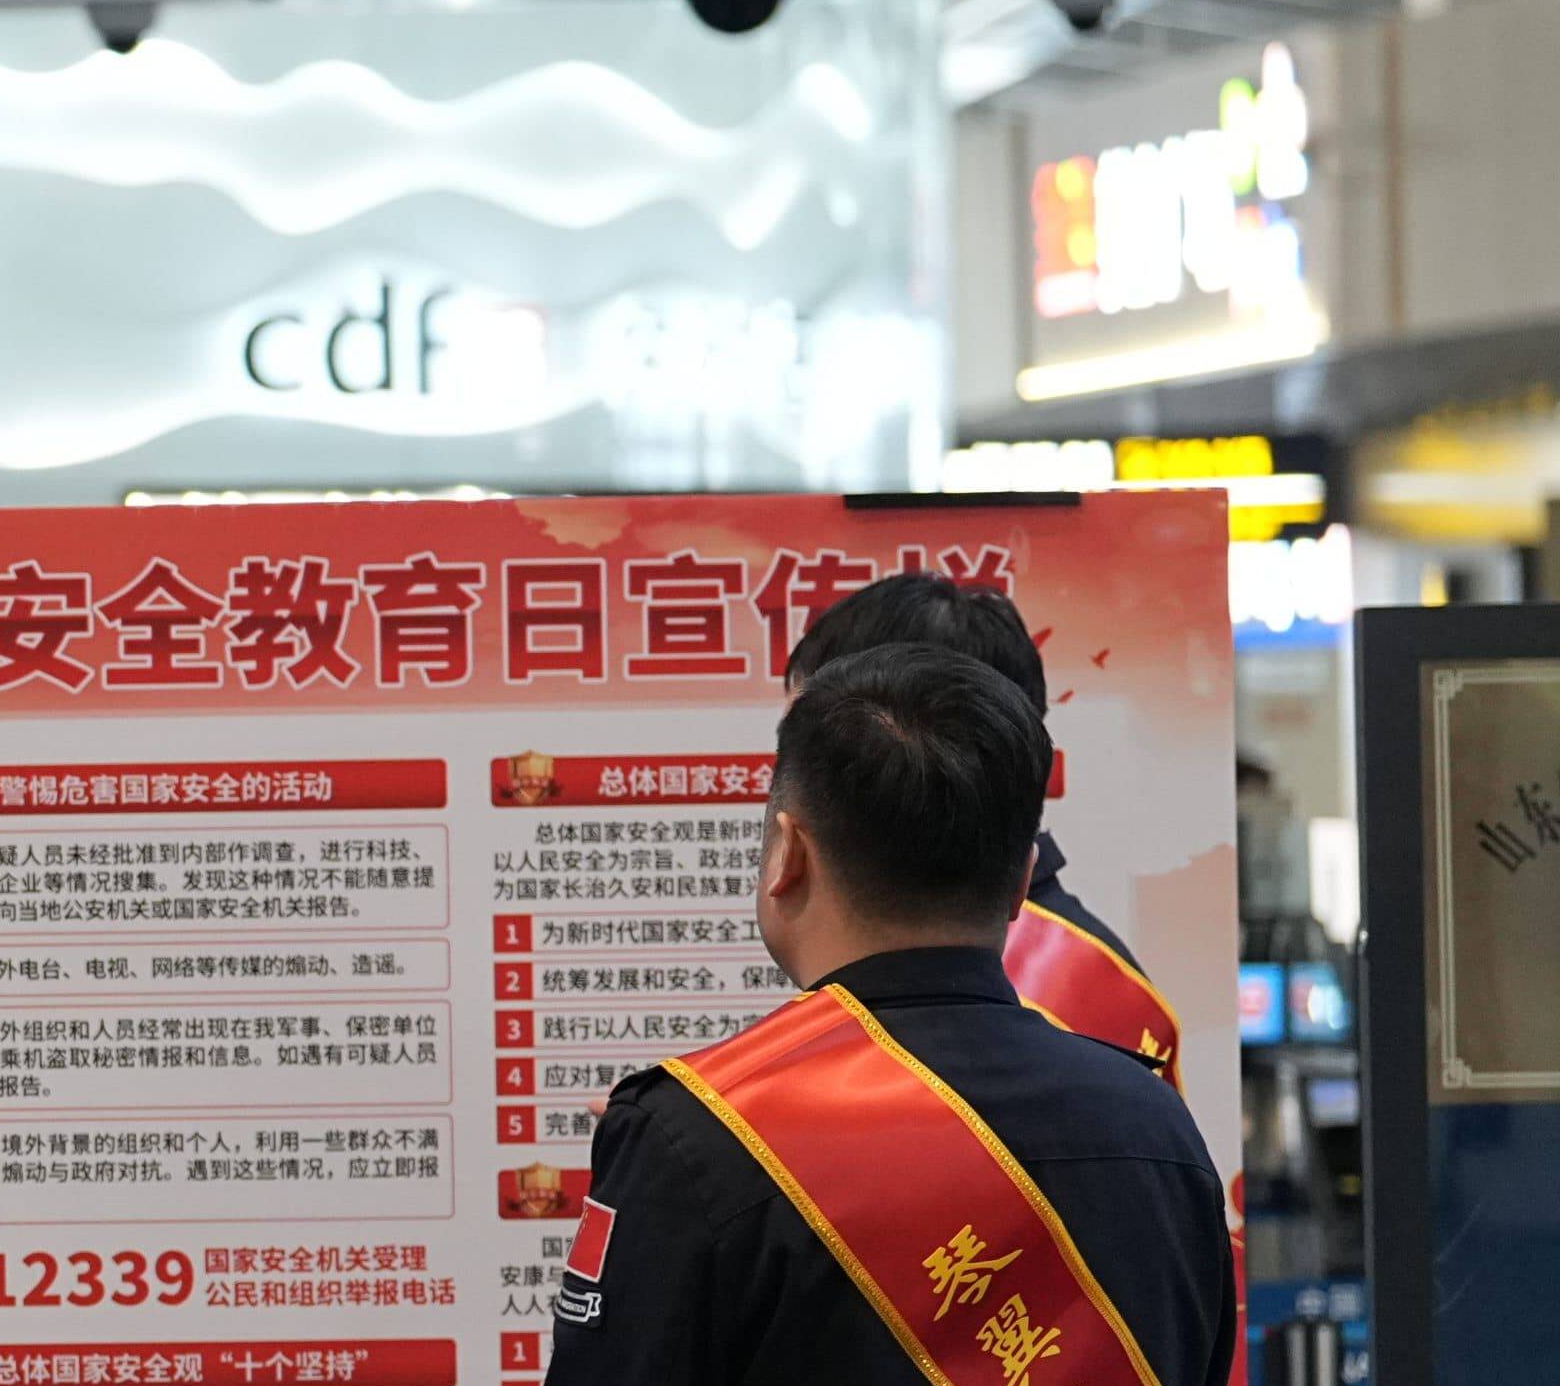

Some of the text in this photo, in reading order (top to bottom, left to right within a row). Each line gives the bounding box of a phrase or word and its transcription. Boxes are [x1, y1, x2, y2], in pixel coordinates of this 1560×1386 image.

[599, 765, 776, 796] 总体国家安全
[536, 821, 763, 844] 总体国家安全观是新时
[506, 921, 761, 944] 1 为新时代国家安全工
[506, 973, 519, 991] 2
[507, 1021, 520, 1039] 3
[508, 1069, 521, 1085] 4
[508, 1116, 522, 1134] 5
[204, 1246, 427, 1273] 国家安全机关受理
[205, 1278, 455, 1307] 公民和组织举报电话
[514, 1344, 525, 1360] 1
